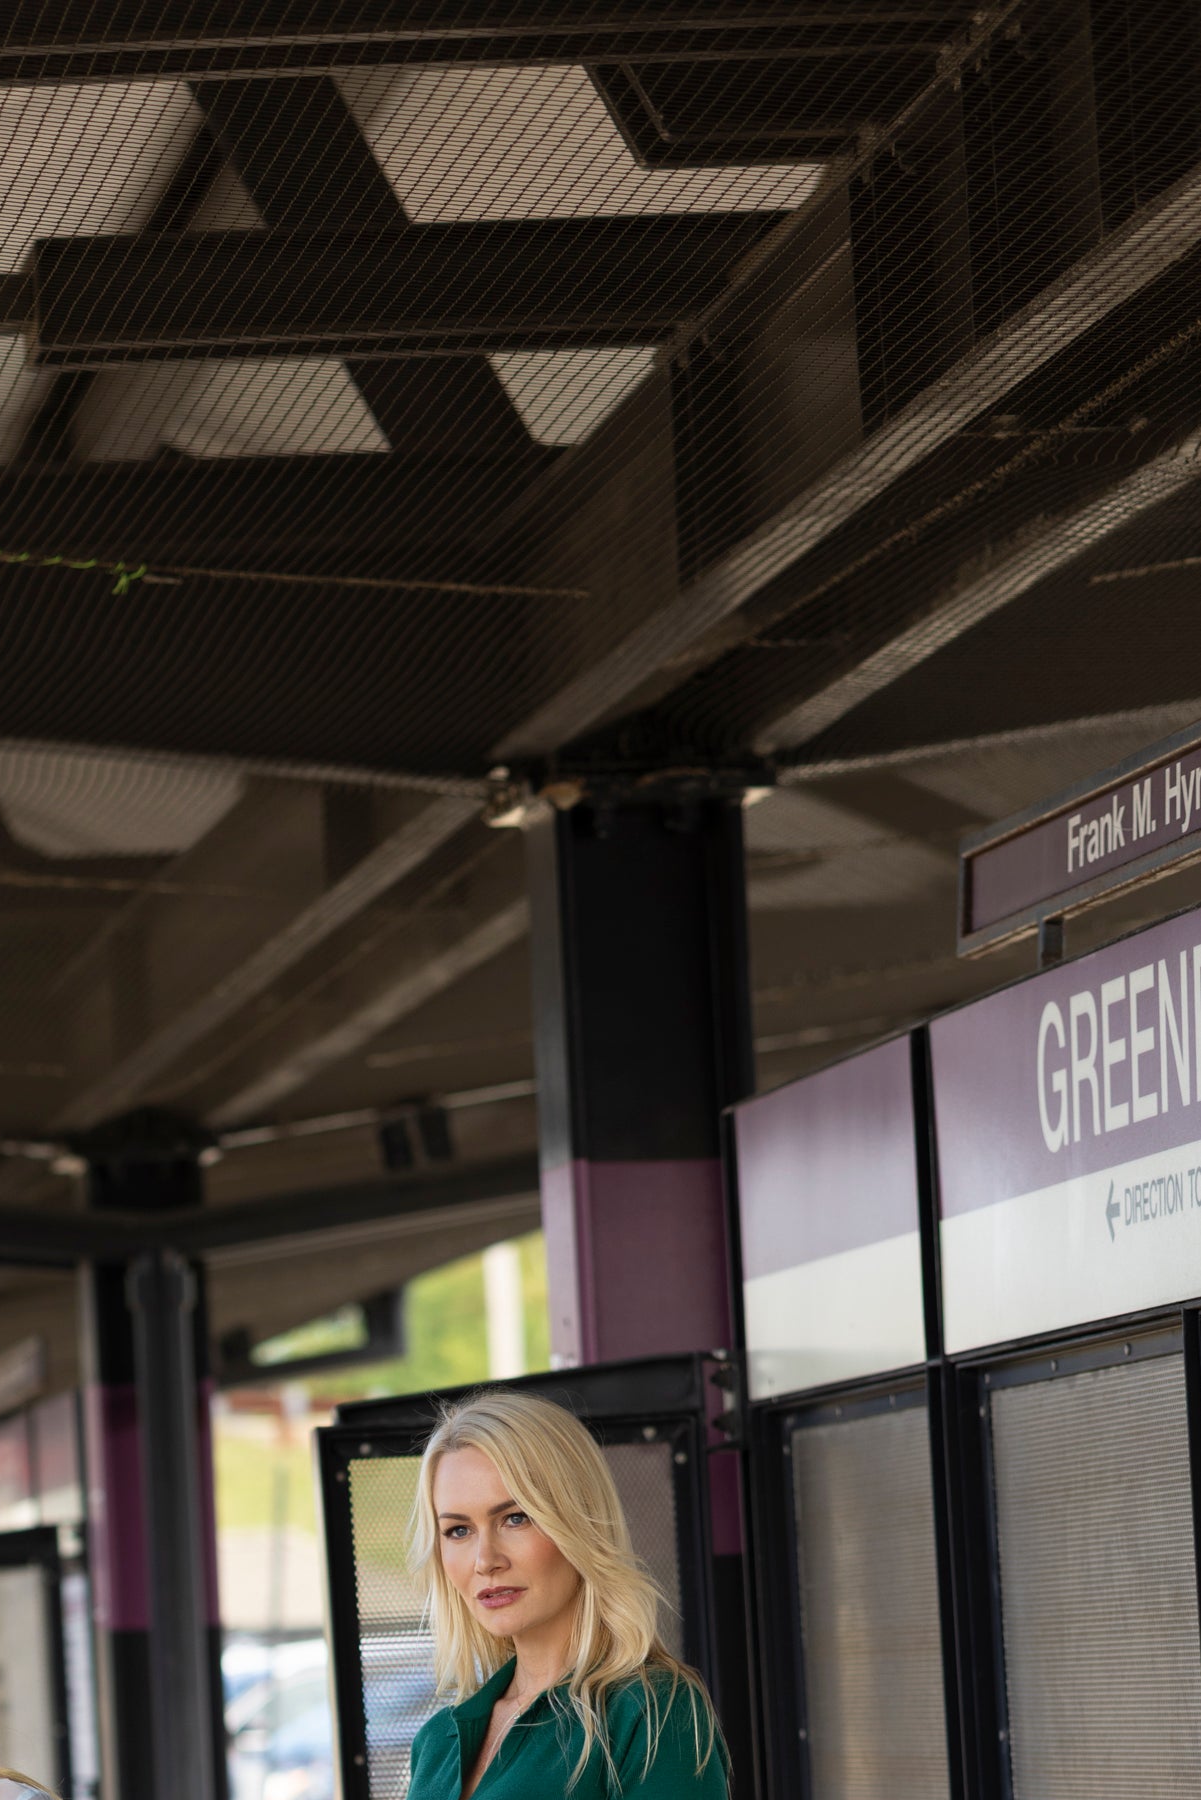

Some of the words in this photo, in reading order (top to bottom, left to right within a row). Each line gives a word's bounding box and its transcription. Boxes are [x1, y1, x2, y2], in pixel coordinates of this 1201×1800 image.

[1067, 794, 1126, 873] Frank
[1132, 777, 1157, 842] M.
[1124, 1171, 1184, 1227] DIRECTION
